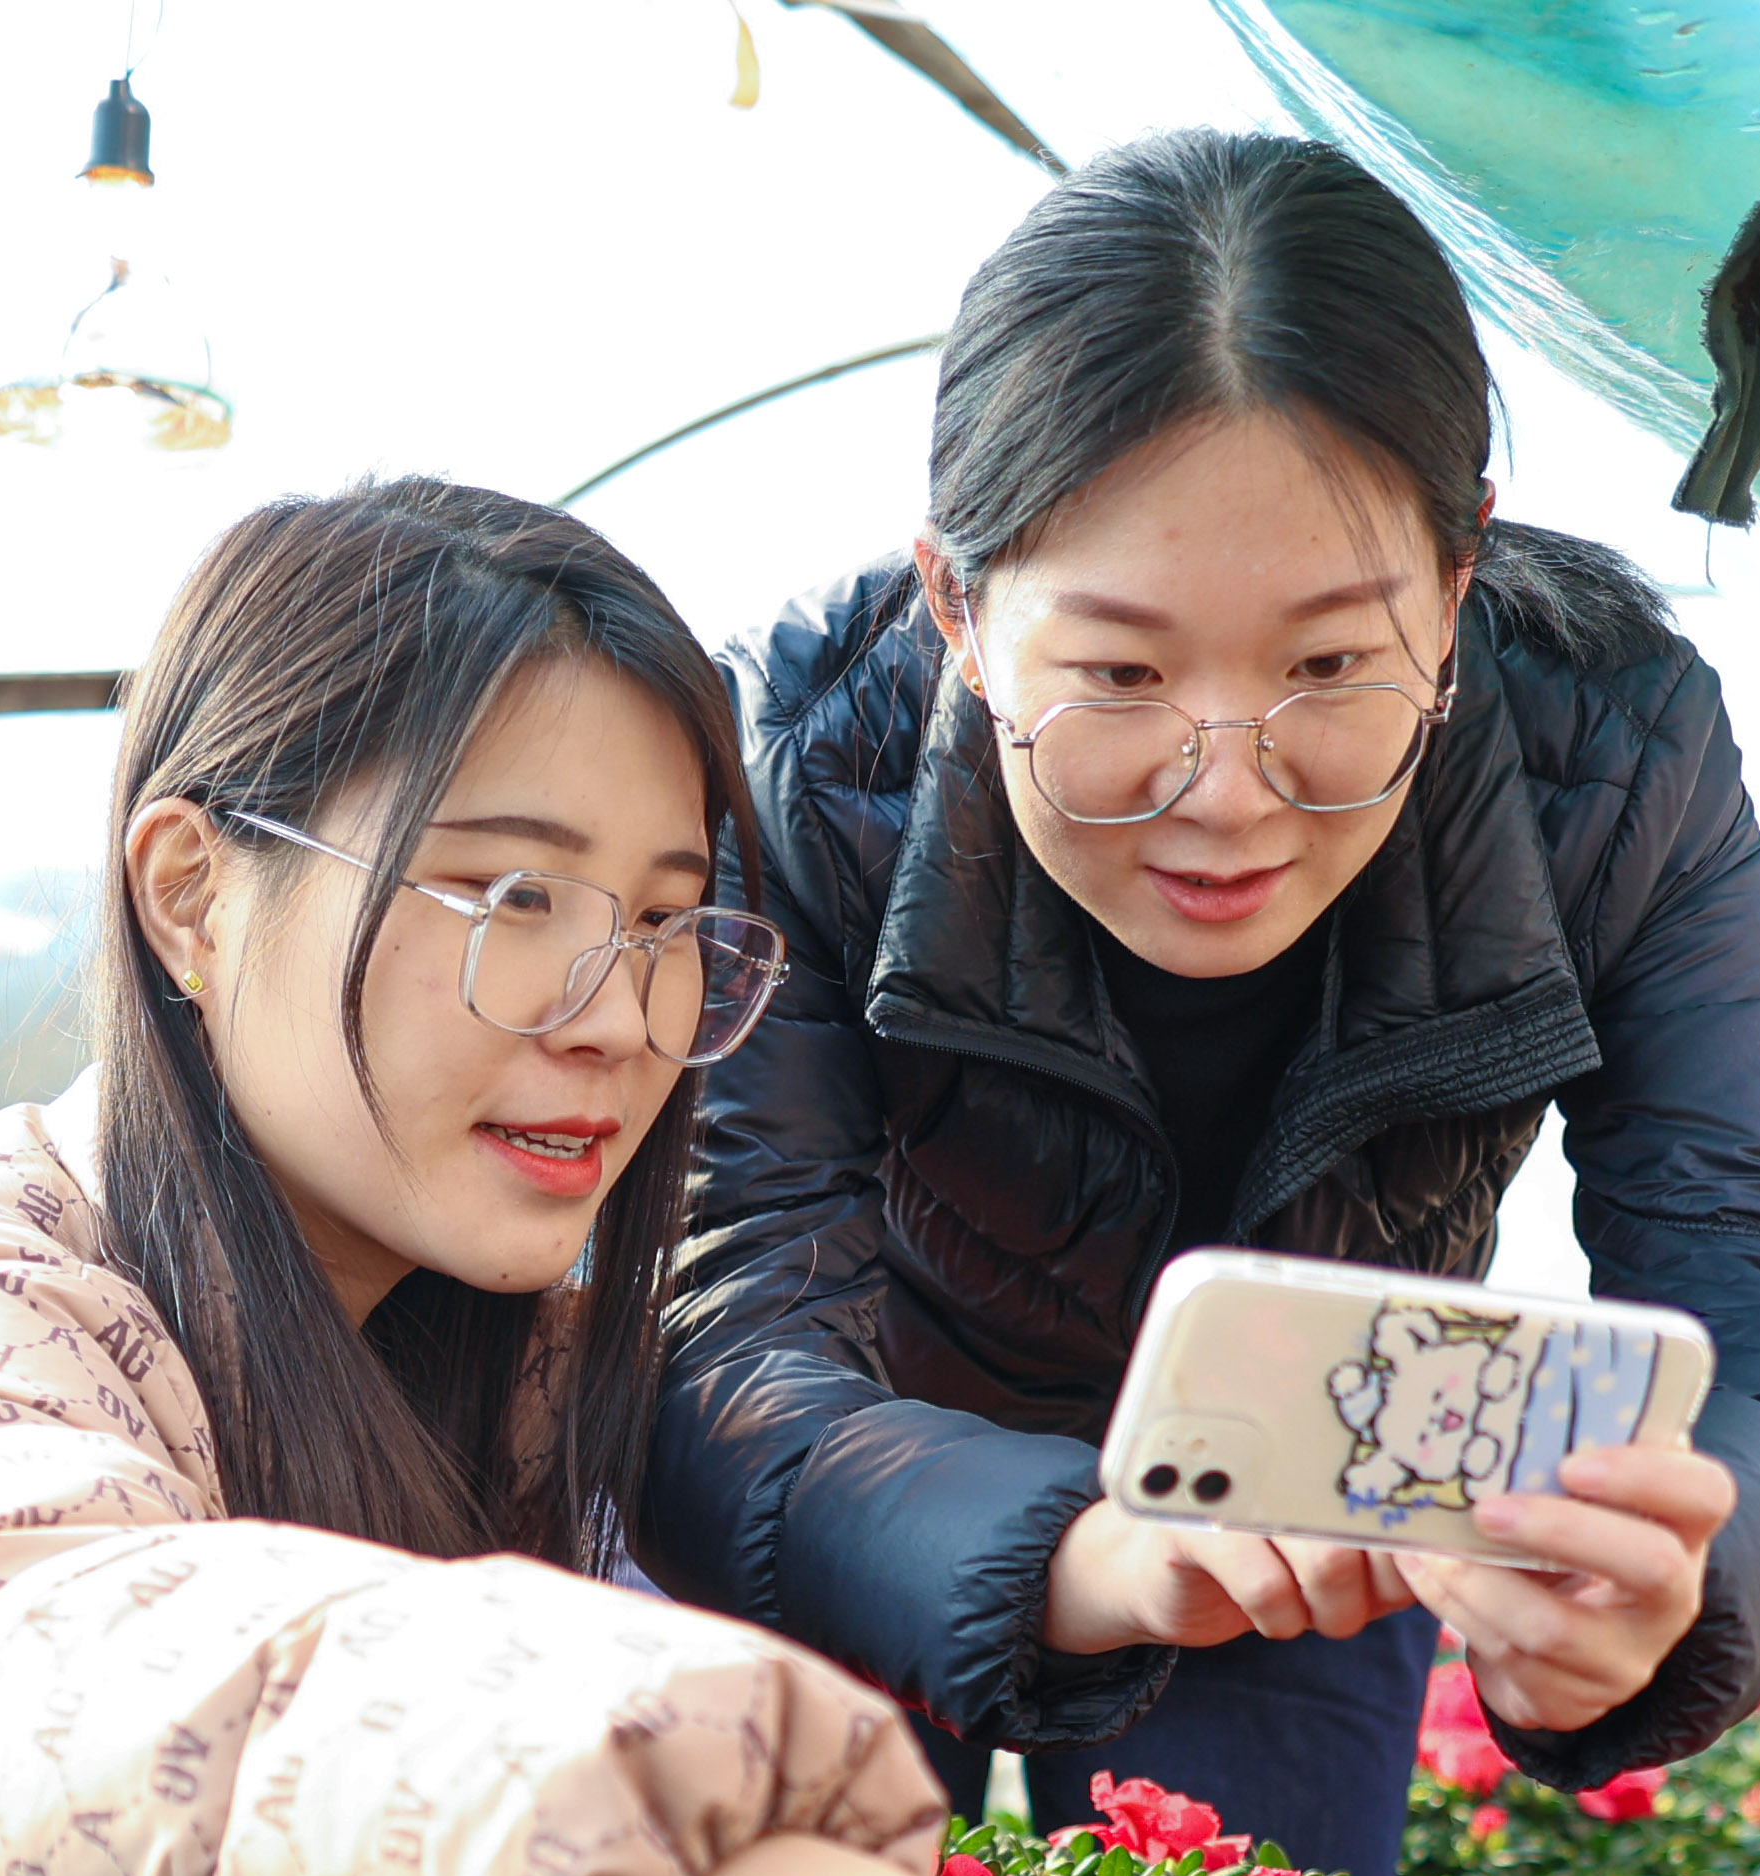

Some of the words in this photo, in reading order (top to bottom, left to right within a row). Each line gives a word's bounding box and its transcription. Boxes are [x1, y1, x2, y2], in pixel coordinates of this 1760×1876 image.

[15, 1183, 64, 1236] AG
[94, 1315, 155, 1383] AG
[97, 1384, 147, 1441] AG
